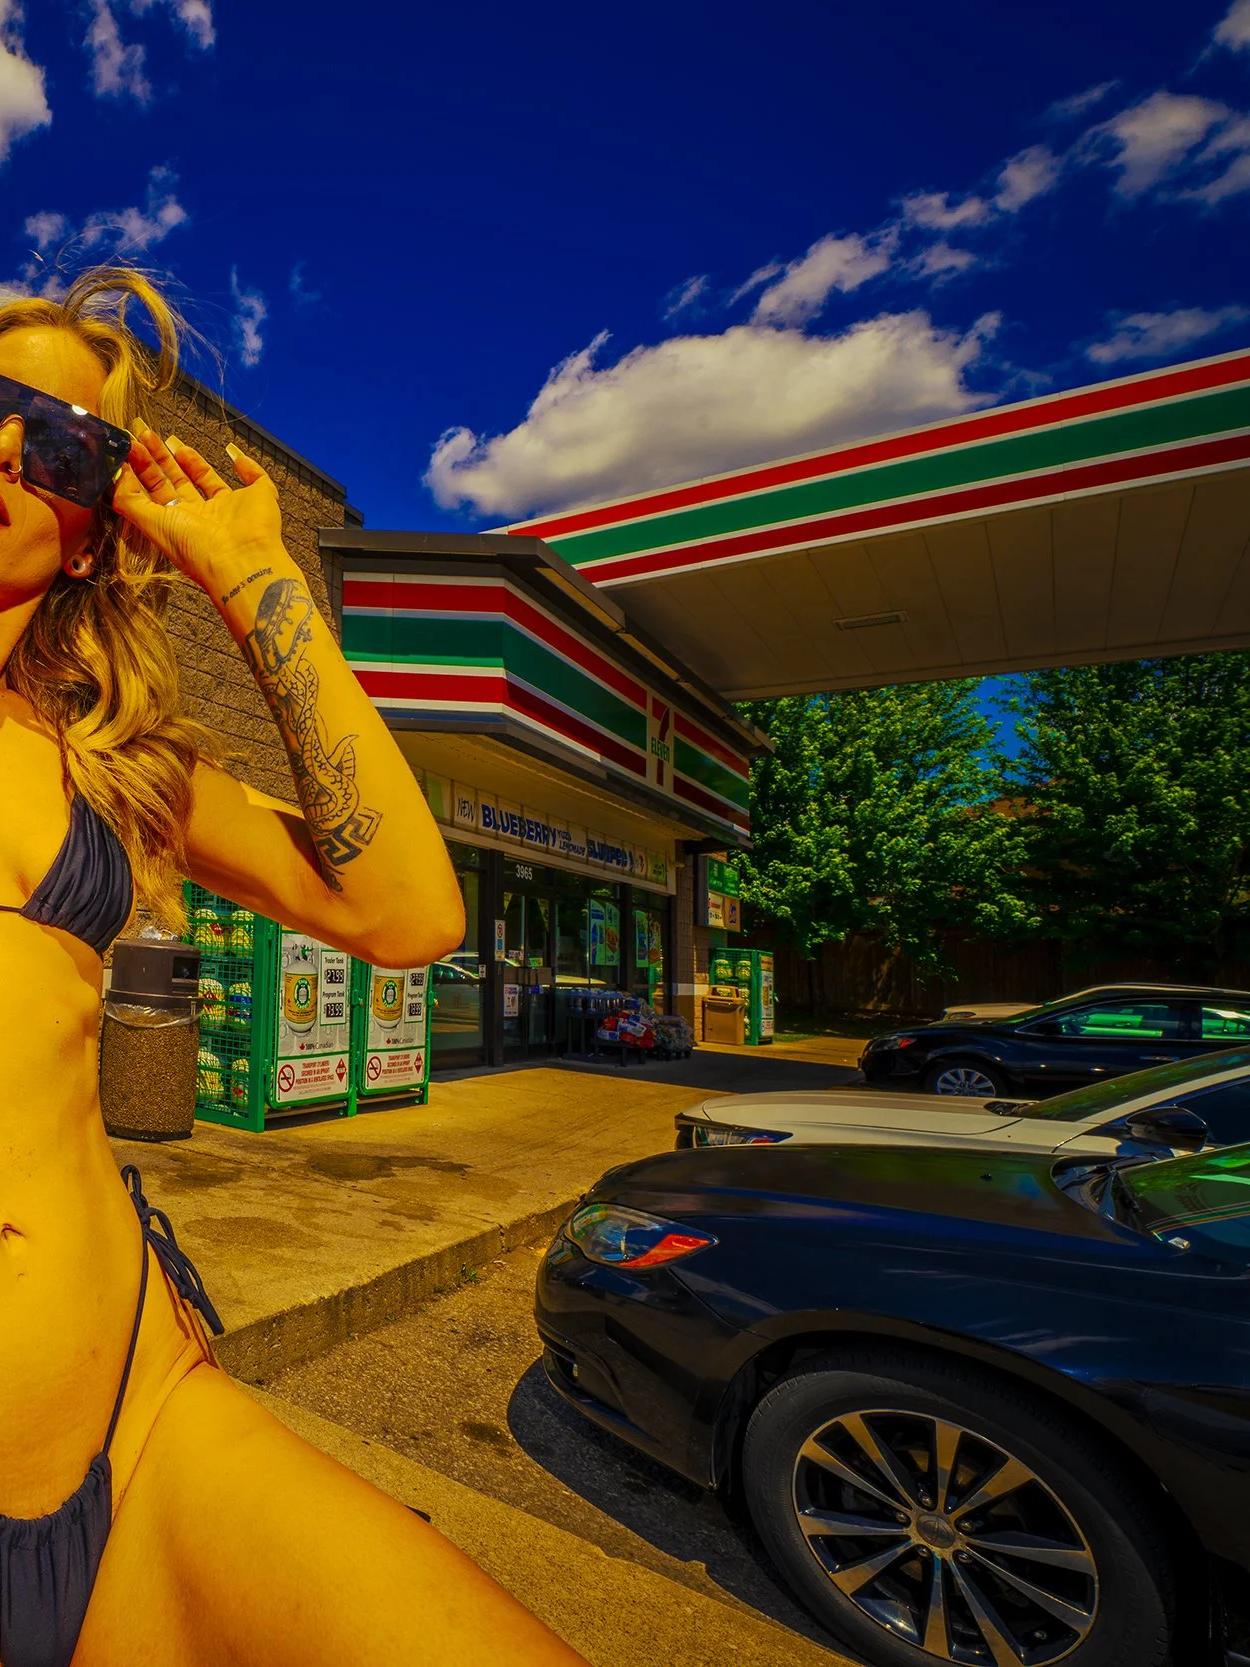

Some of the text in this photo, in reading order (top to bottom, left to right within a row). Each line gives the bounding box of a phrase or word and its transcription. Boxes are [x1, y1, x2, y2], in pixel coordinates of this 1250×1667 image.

[652, 696, 671, 787] 7
[456, 797, 557, 848] NEW BLUEBERRY
[559, 841, 586, 856] LEMONADE
[515, 864, 533, 880] 3965
[322, 992, 336, 1000] Program
